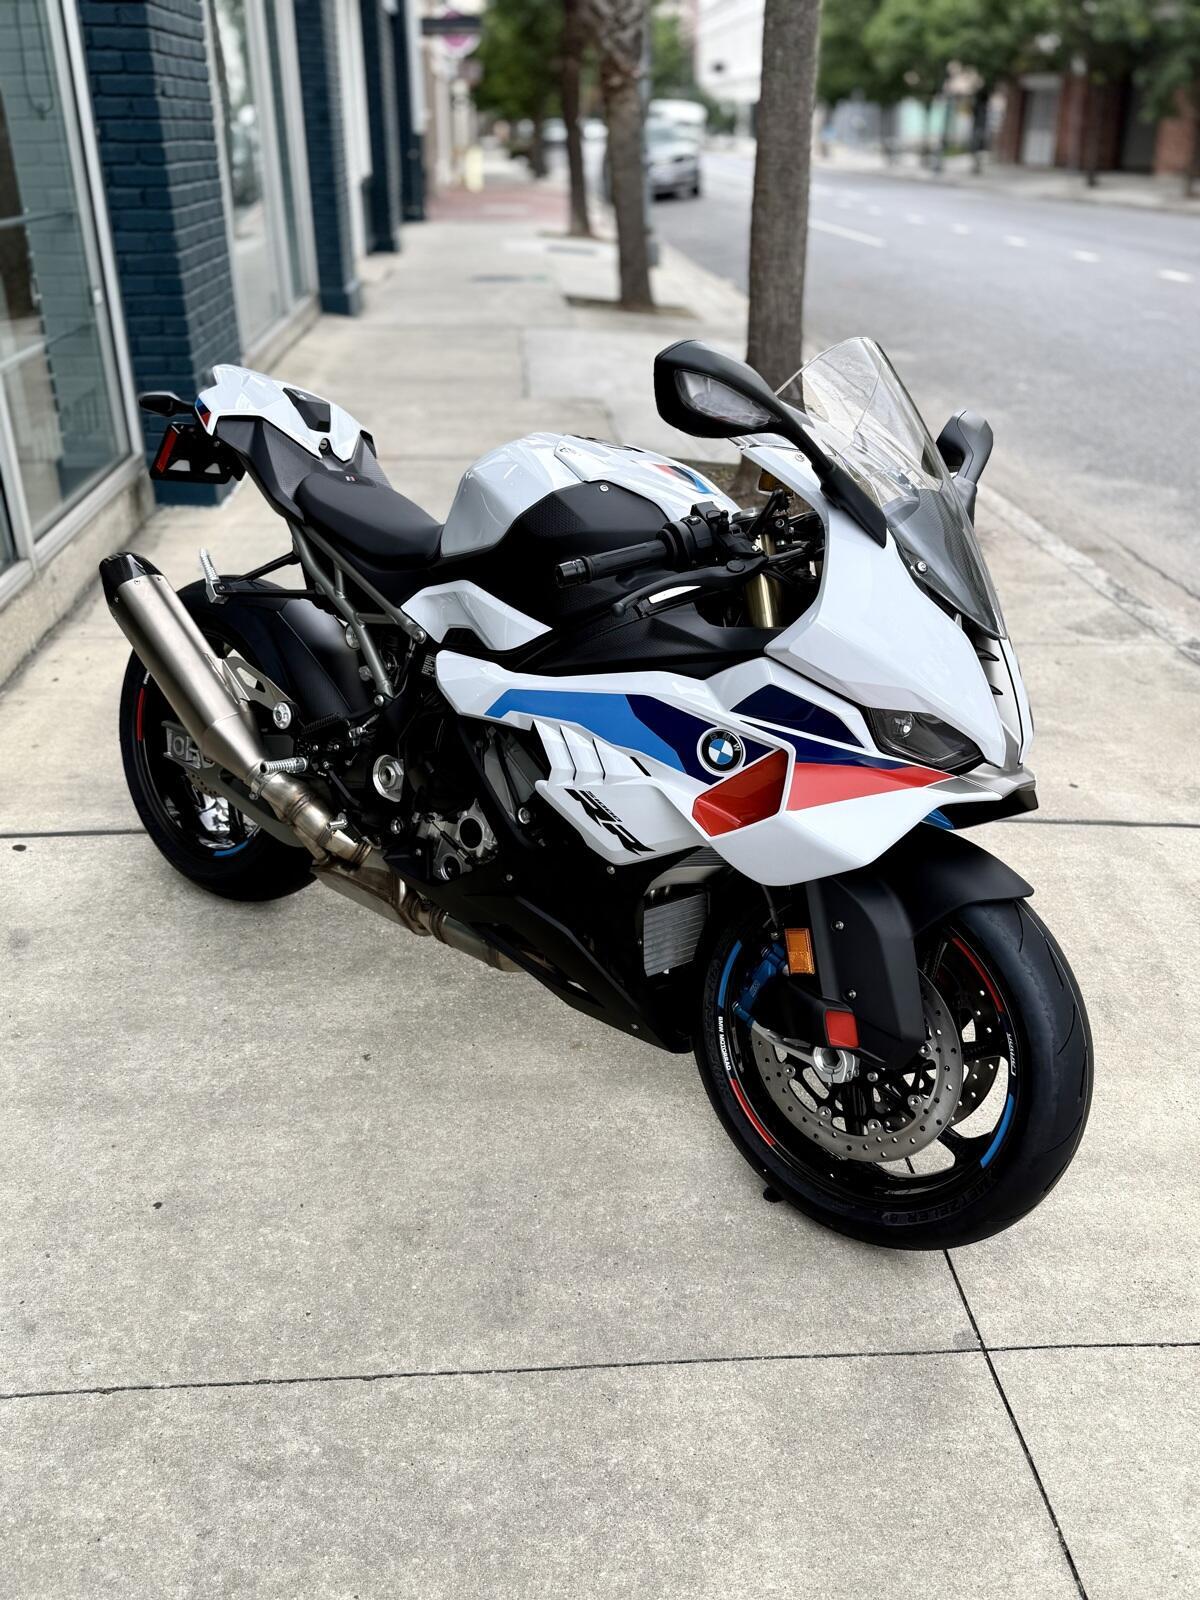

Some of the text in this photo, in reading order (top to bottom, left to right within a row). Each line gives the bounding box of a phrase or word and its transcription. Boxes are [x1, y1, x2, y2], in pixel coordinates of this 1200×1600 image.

[709, 731, 741, 752] BMW
[563, 787, 657, 857] RR
[719, 1033, 731, 1071] MOTORRAD
